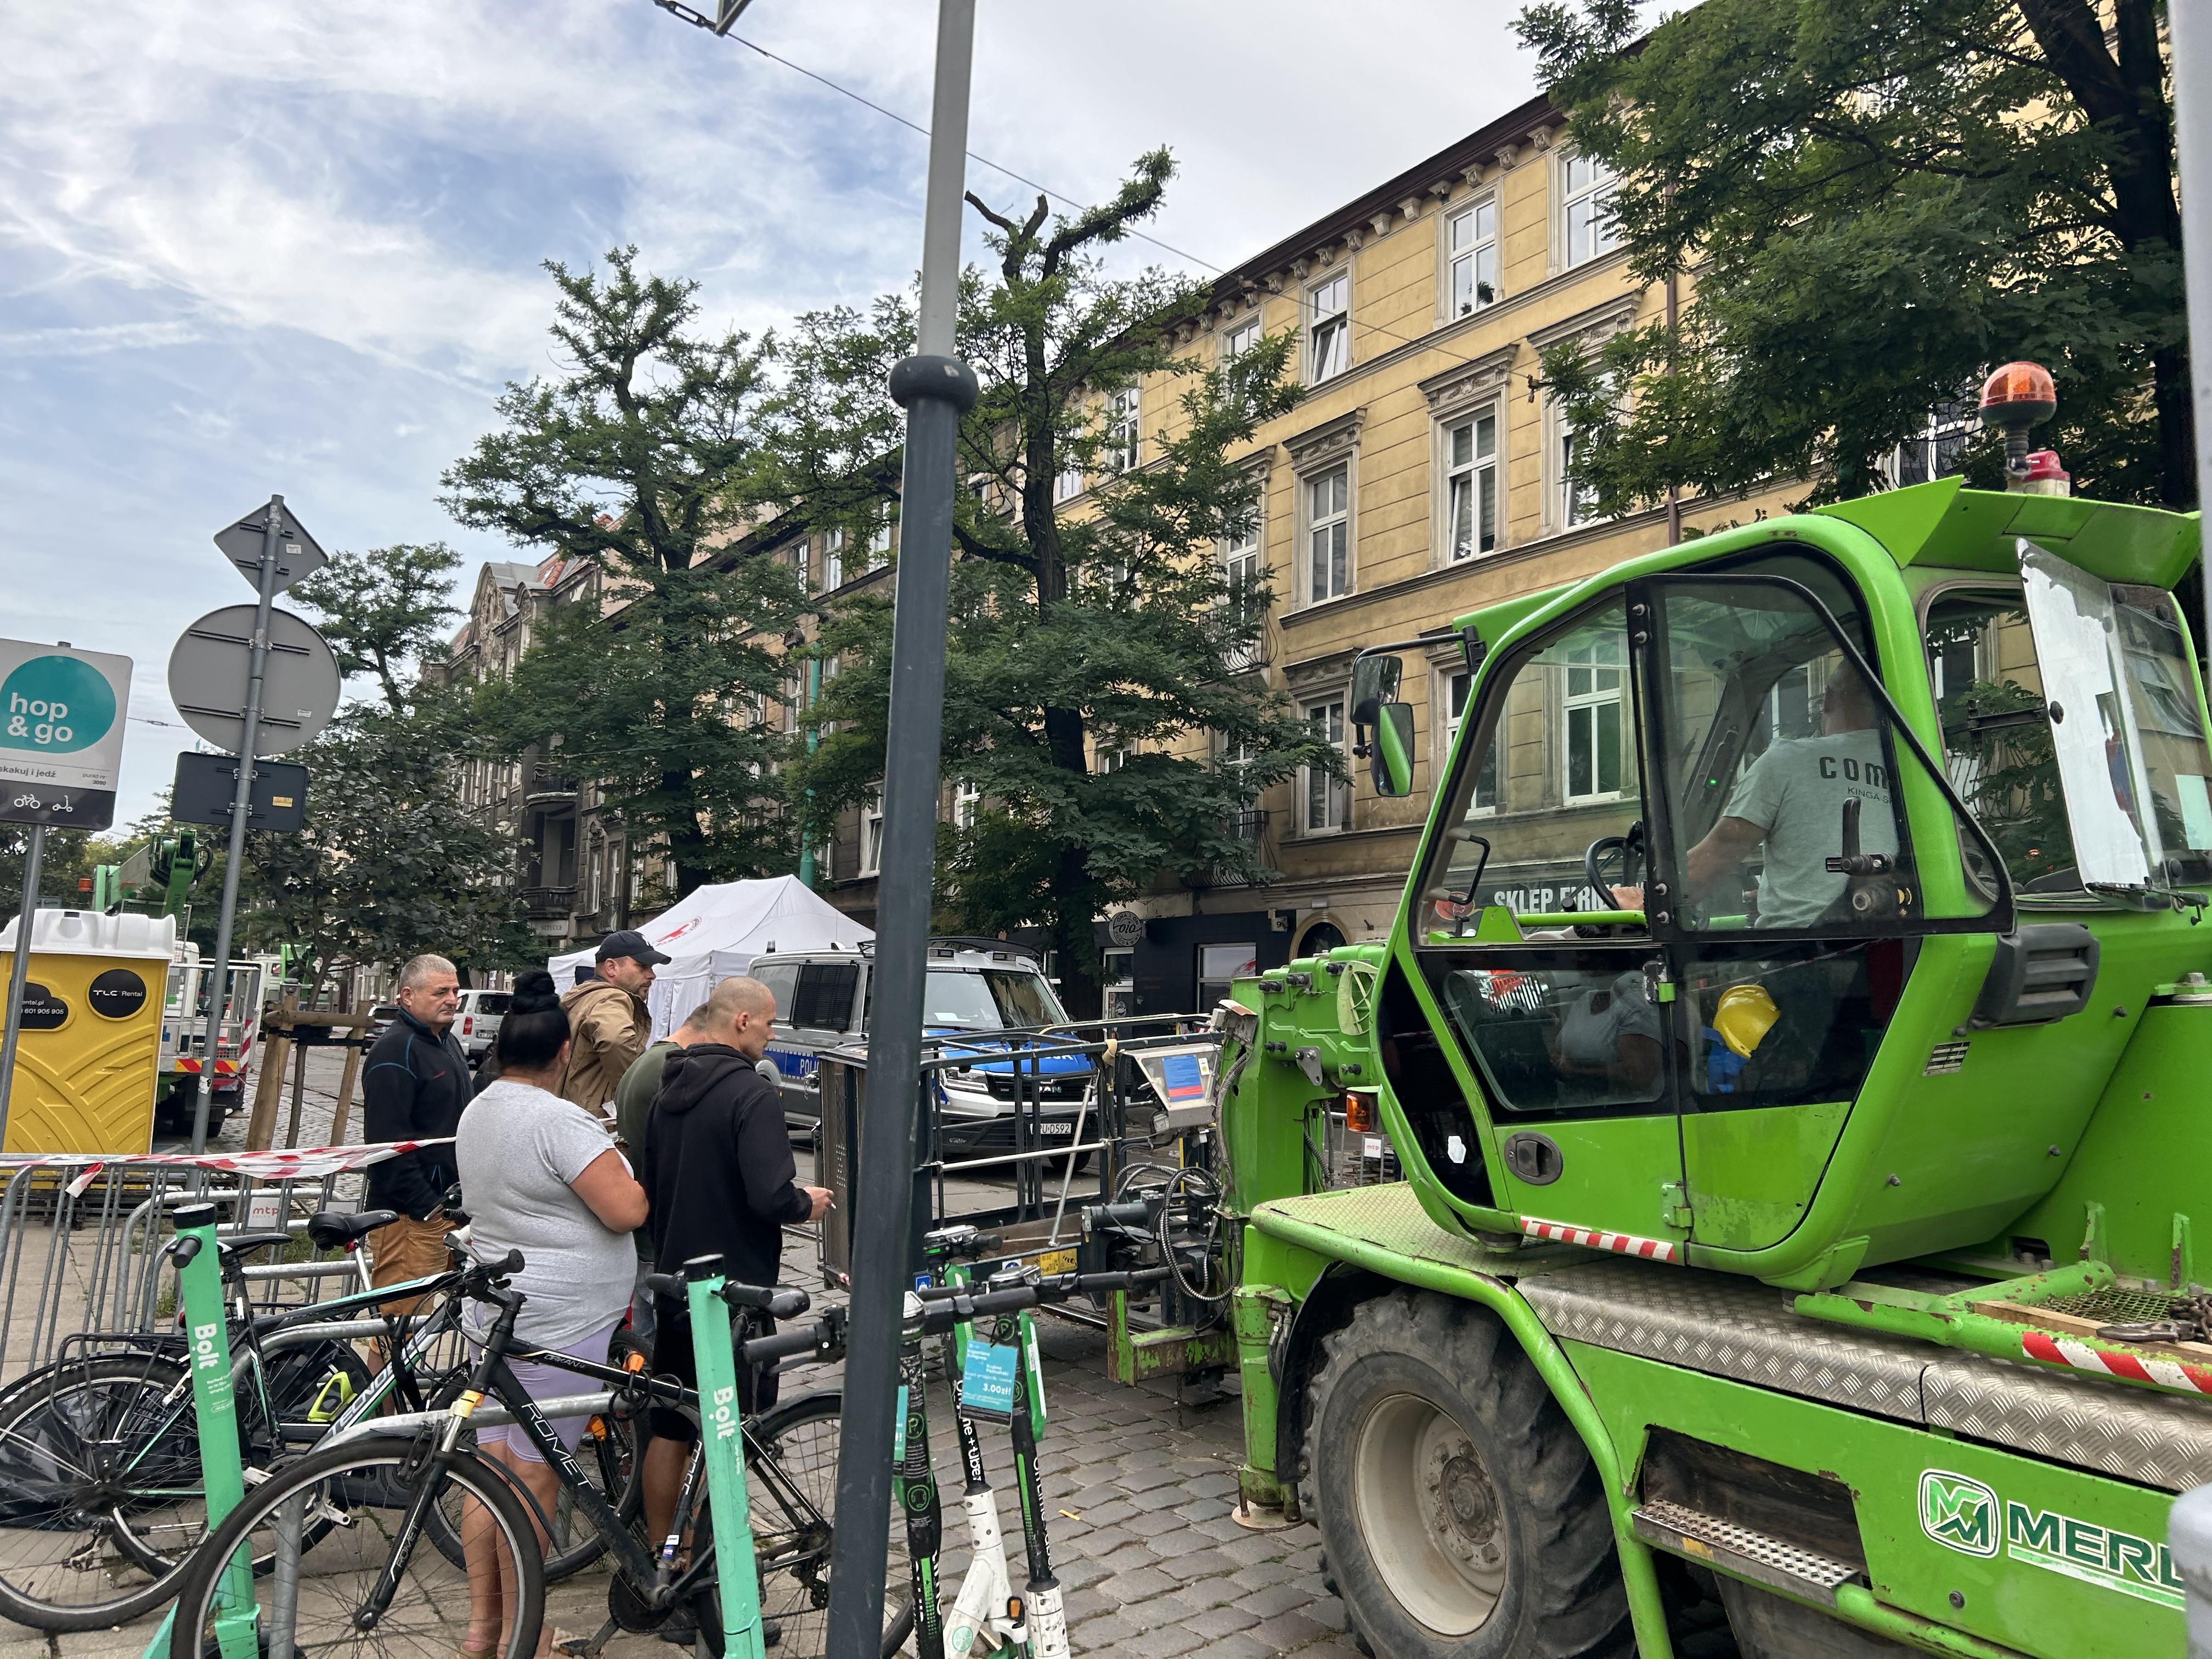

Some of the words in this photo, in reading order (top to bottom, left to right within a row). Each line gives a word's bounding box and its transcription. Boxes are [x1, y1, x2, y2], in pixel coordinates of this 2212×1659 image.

[10, 692, 68, 723] hop
[8, 715, 29, 737] &
[34, 723, 73, 744] go
[35, 769, 57, 778] jedź
[1848, 786, 1881, 802] KINGA
[1882, 795, 1892, 804] S
[1493, 888, 1554, 915] SKLEP
[1117, 913, 1127, 922] ONA
[252, 1206, 279, 1217] mtp
[192, 1323, 219, 1370] Bolt
[708, 1386, 736, 1440] Bolt
[521, 1402, 595, 1489] ROMET
[396, 1521, 419, 1568] ROMET
[2006, 1499, 2186, 1591] MERL
